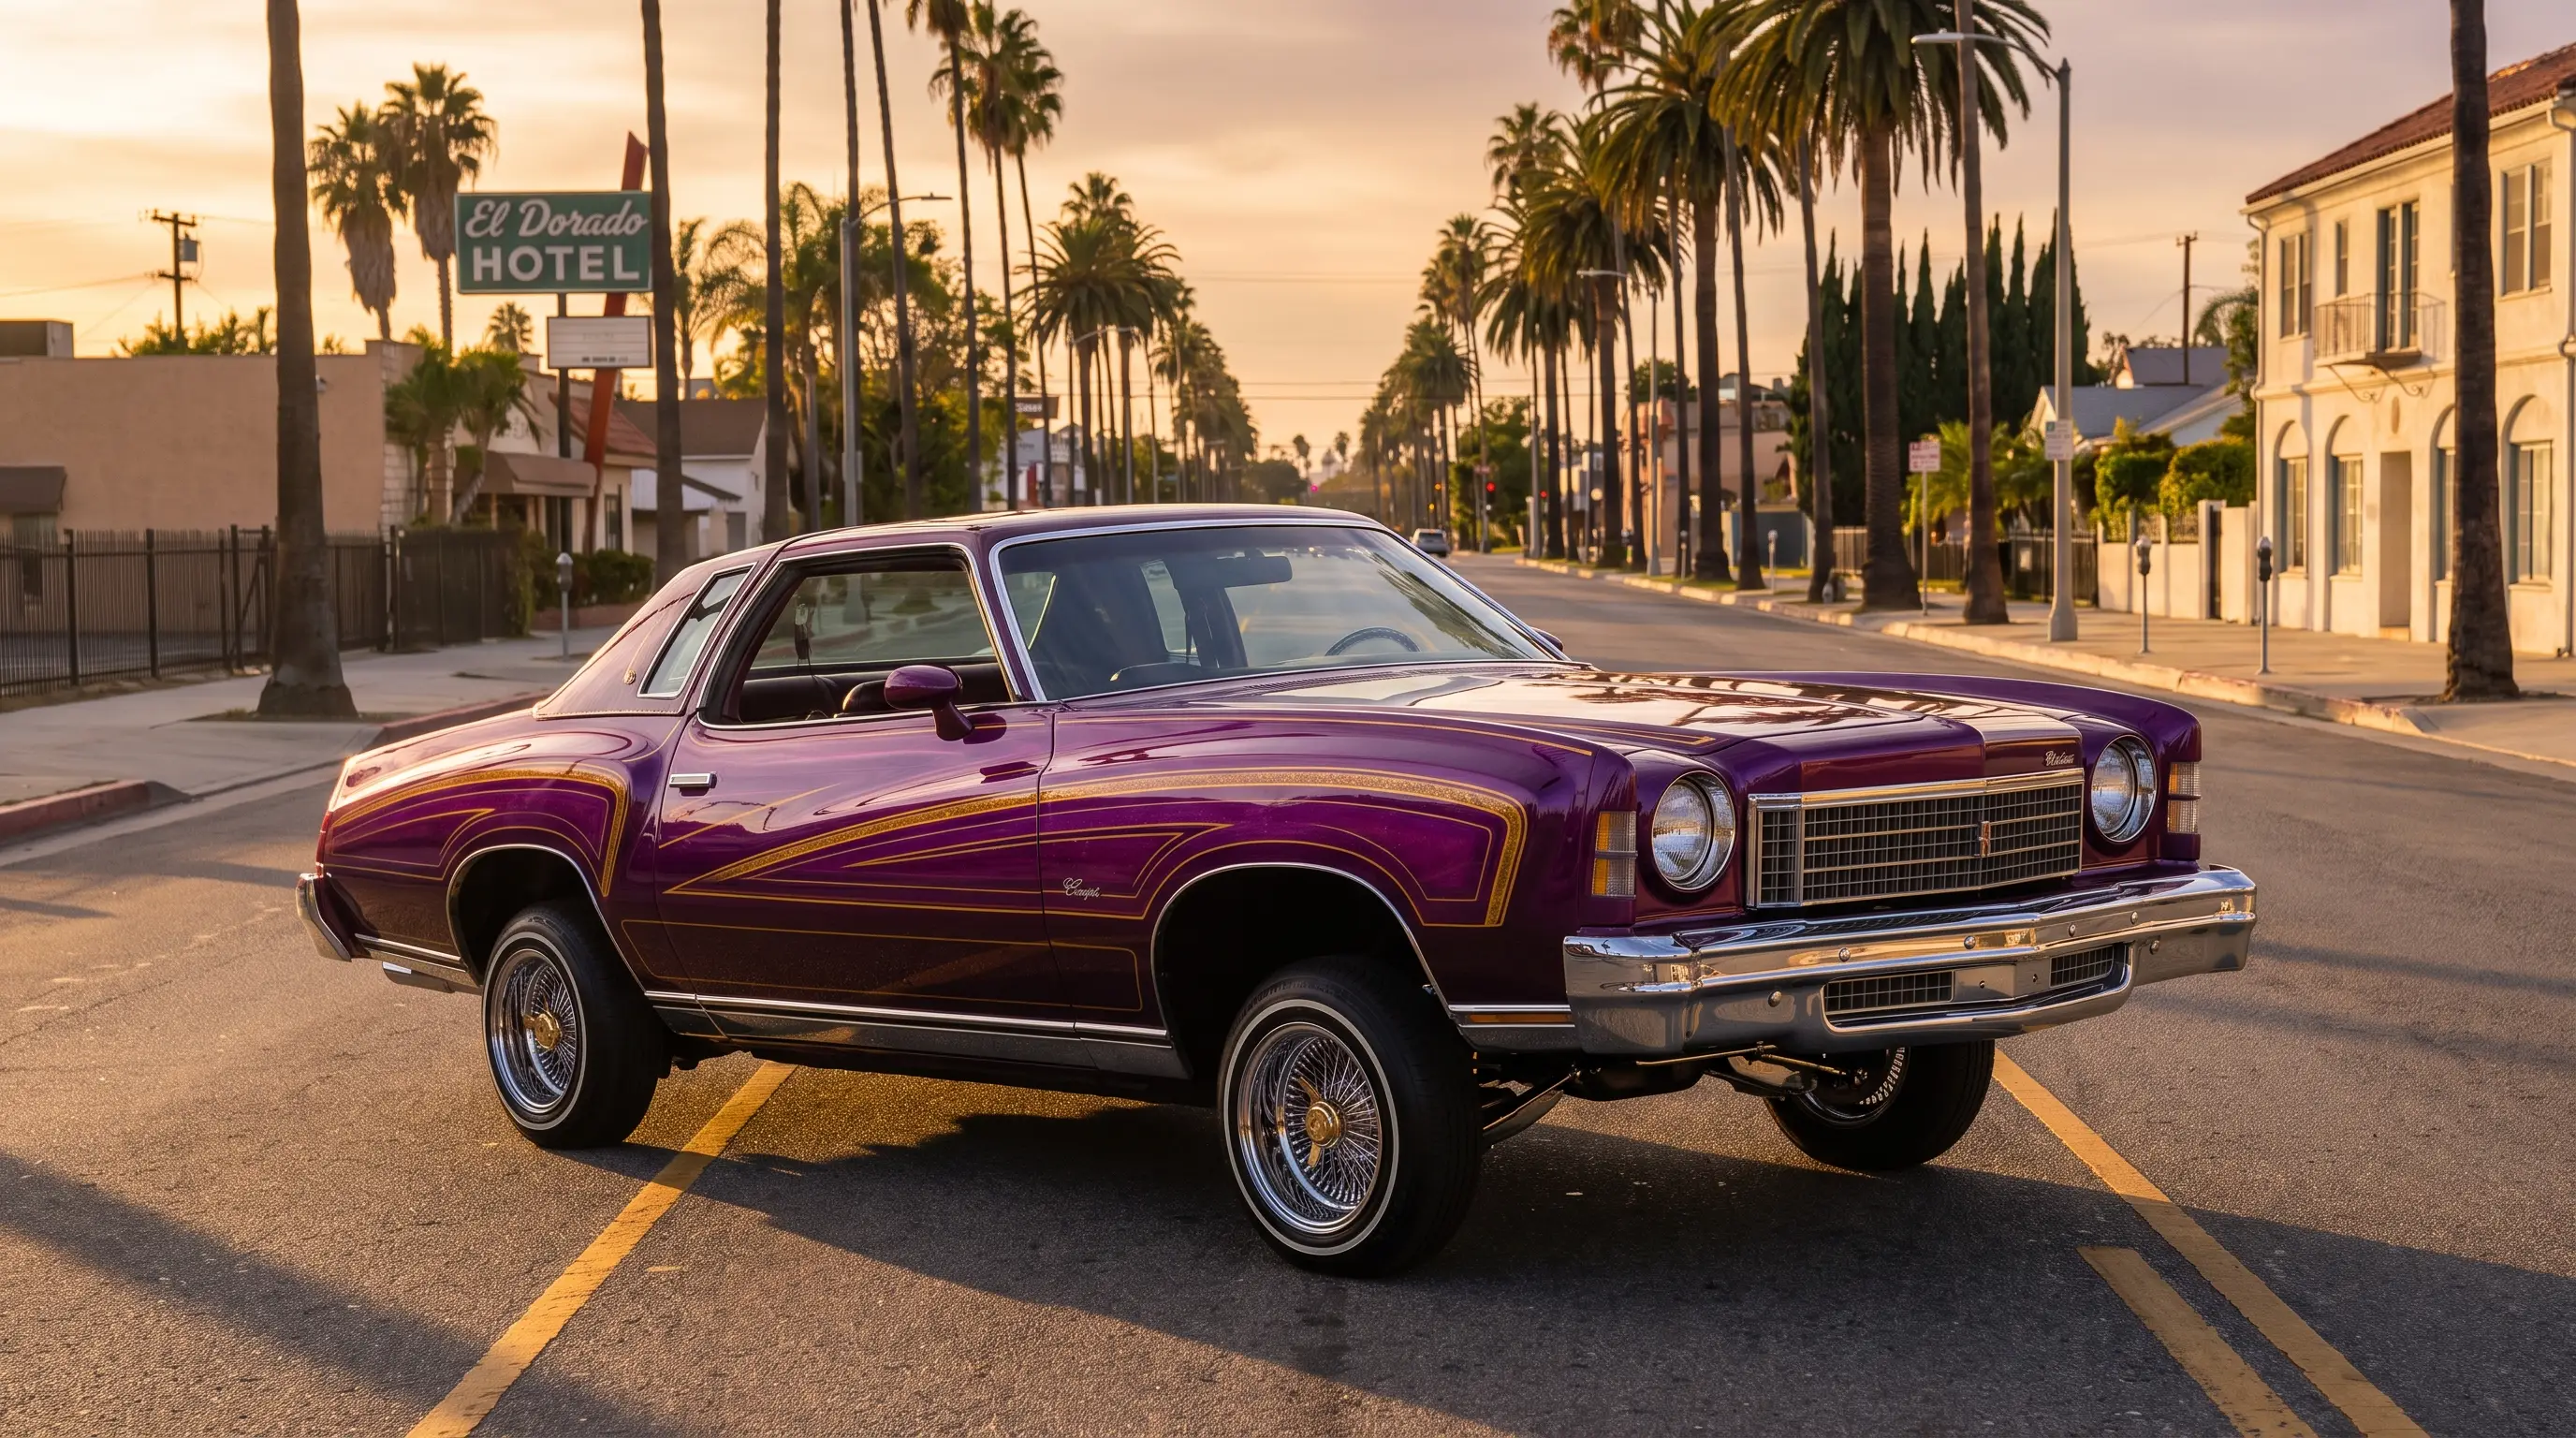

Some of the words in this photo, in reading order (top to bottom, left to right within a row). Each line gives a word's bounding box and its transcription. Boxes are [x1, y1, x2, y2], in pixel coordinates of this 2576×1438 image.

[465, 199, 511, 239] El
[519, 198, 649, 238] Dorado
[473, 245, 640, 282] HOTEL
